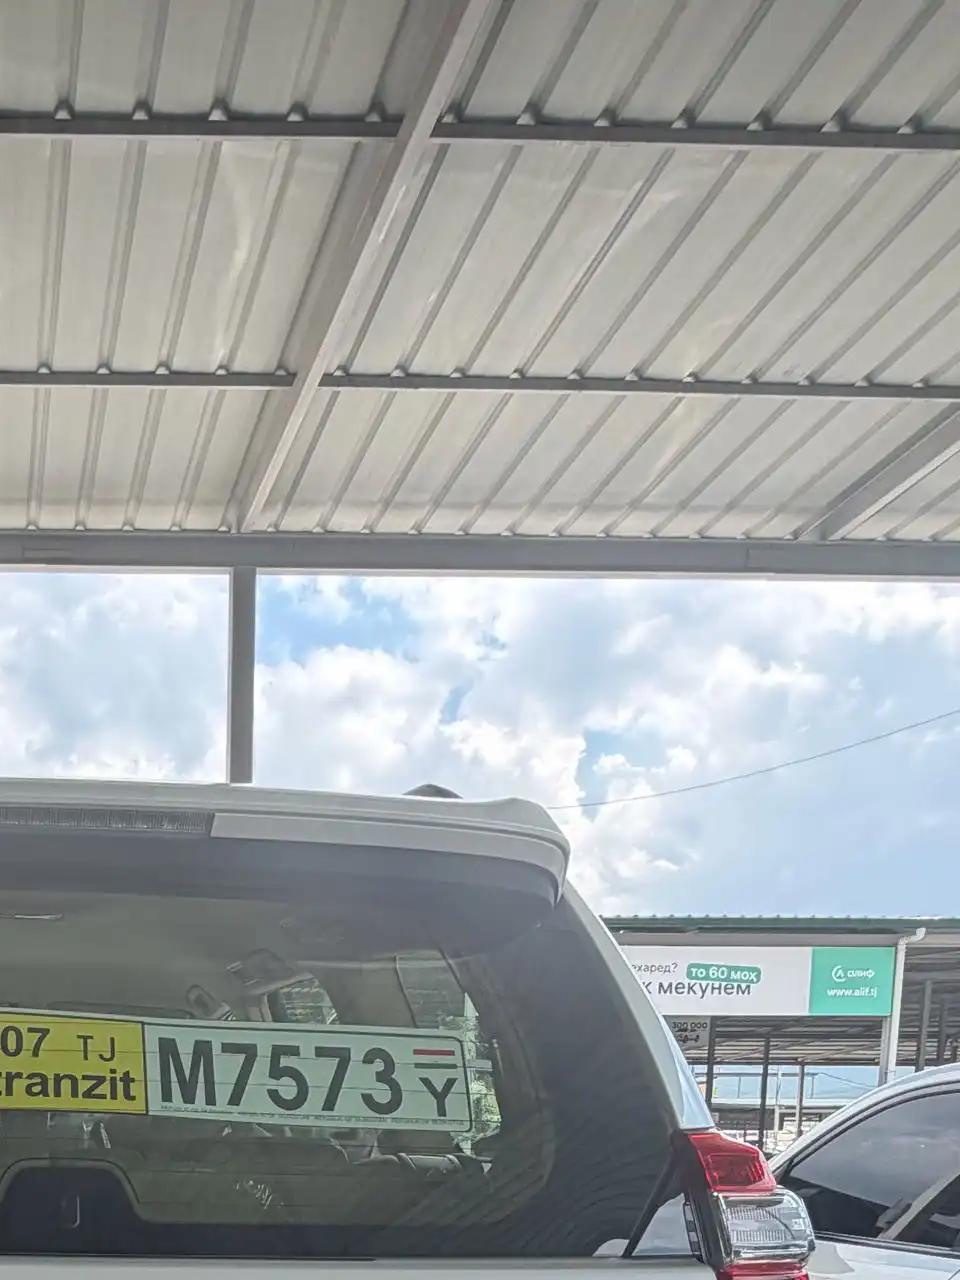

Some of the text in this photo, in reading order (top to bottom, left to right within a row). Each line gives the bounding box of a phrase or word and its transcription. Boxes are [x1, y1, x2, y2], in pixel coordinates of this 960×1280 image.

[691, 968, 706, 978] то
[708, 966, 728, 979] 60
[657, 981, 751, 999] мекунем
[826, 987, 878, 998] www.alif.tj
[0, 1026, 116, 1062] 07 TJ
[158, 1037, 403, 1115] M7573
[418, 1076, 457, 1118] Y
